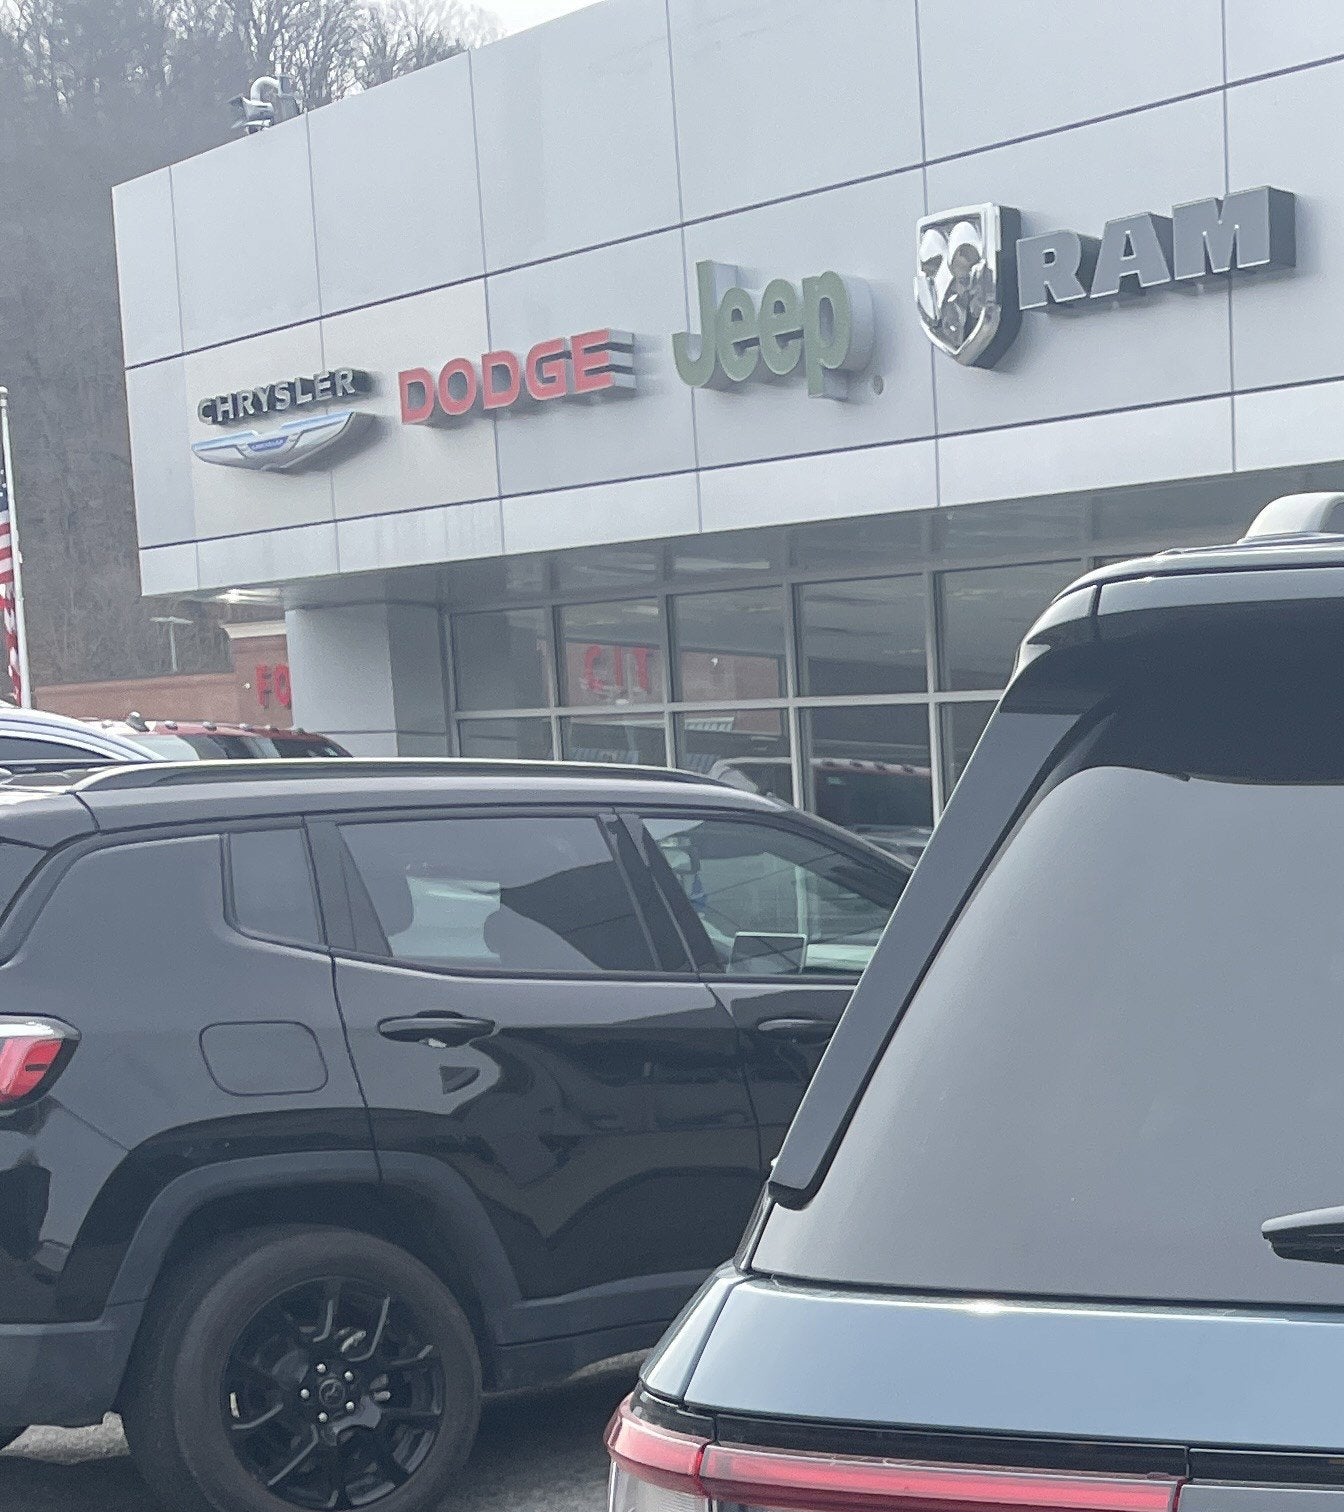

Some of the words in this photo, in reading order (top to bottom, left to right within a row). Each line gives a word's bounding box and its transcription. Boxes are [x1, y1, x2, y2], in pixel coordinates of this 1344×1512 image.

[1014, 185, 1288, 311] RAM
[398, 328, 628, 426] DODGE
[672, 259, 864, 399] Jeep
[197, 367, 368, 426] CHRYSLER
